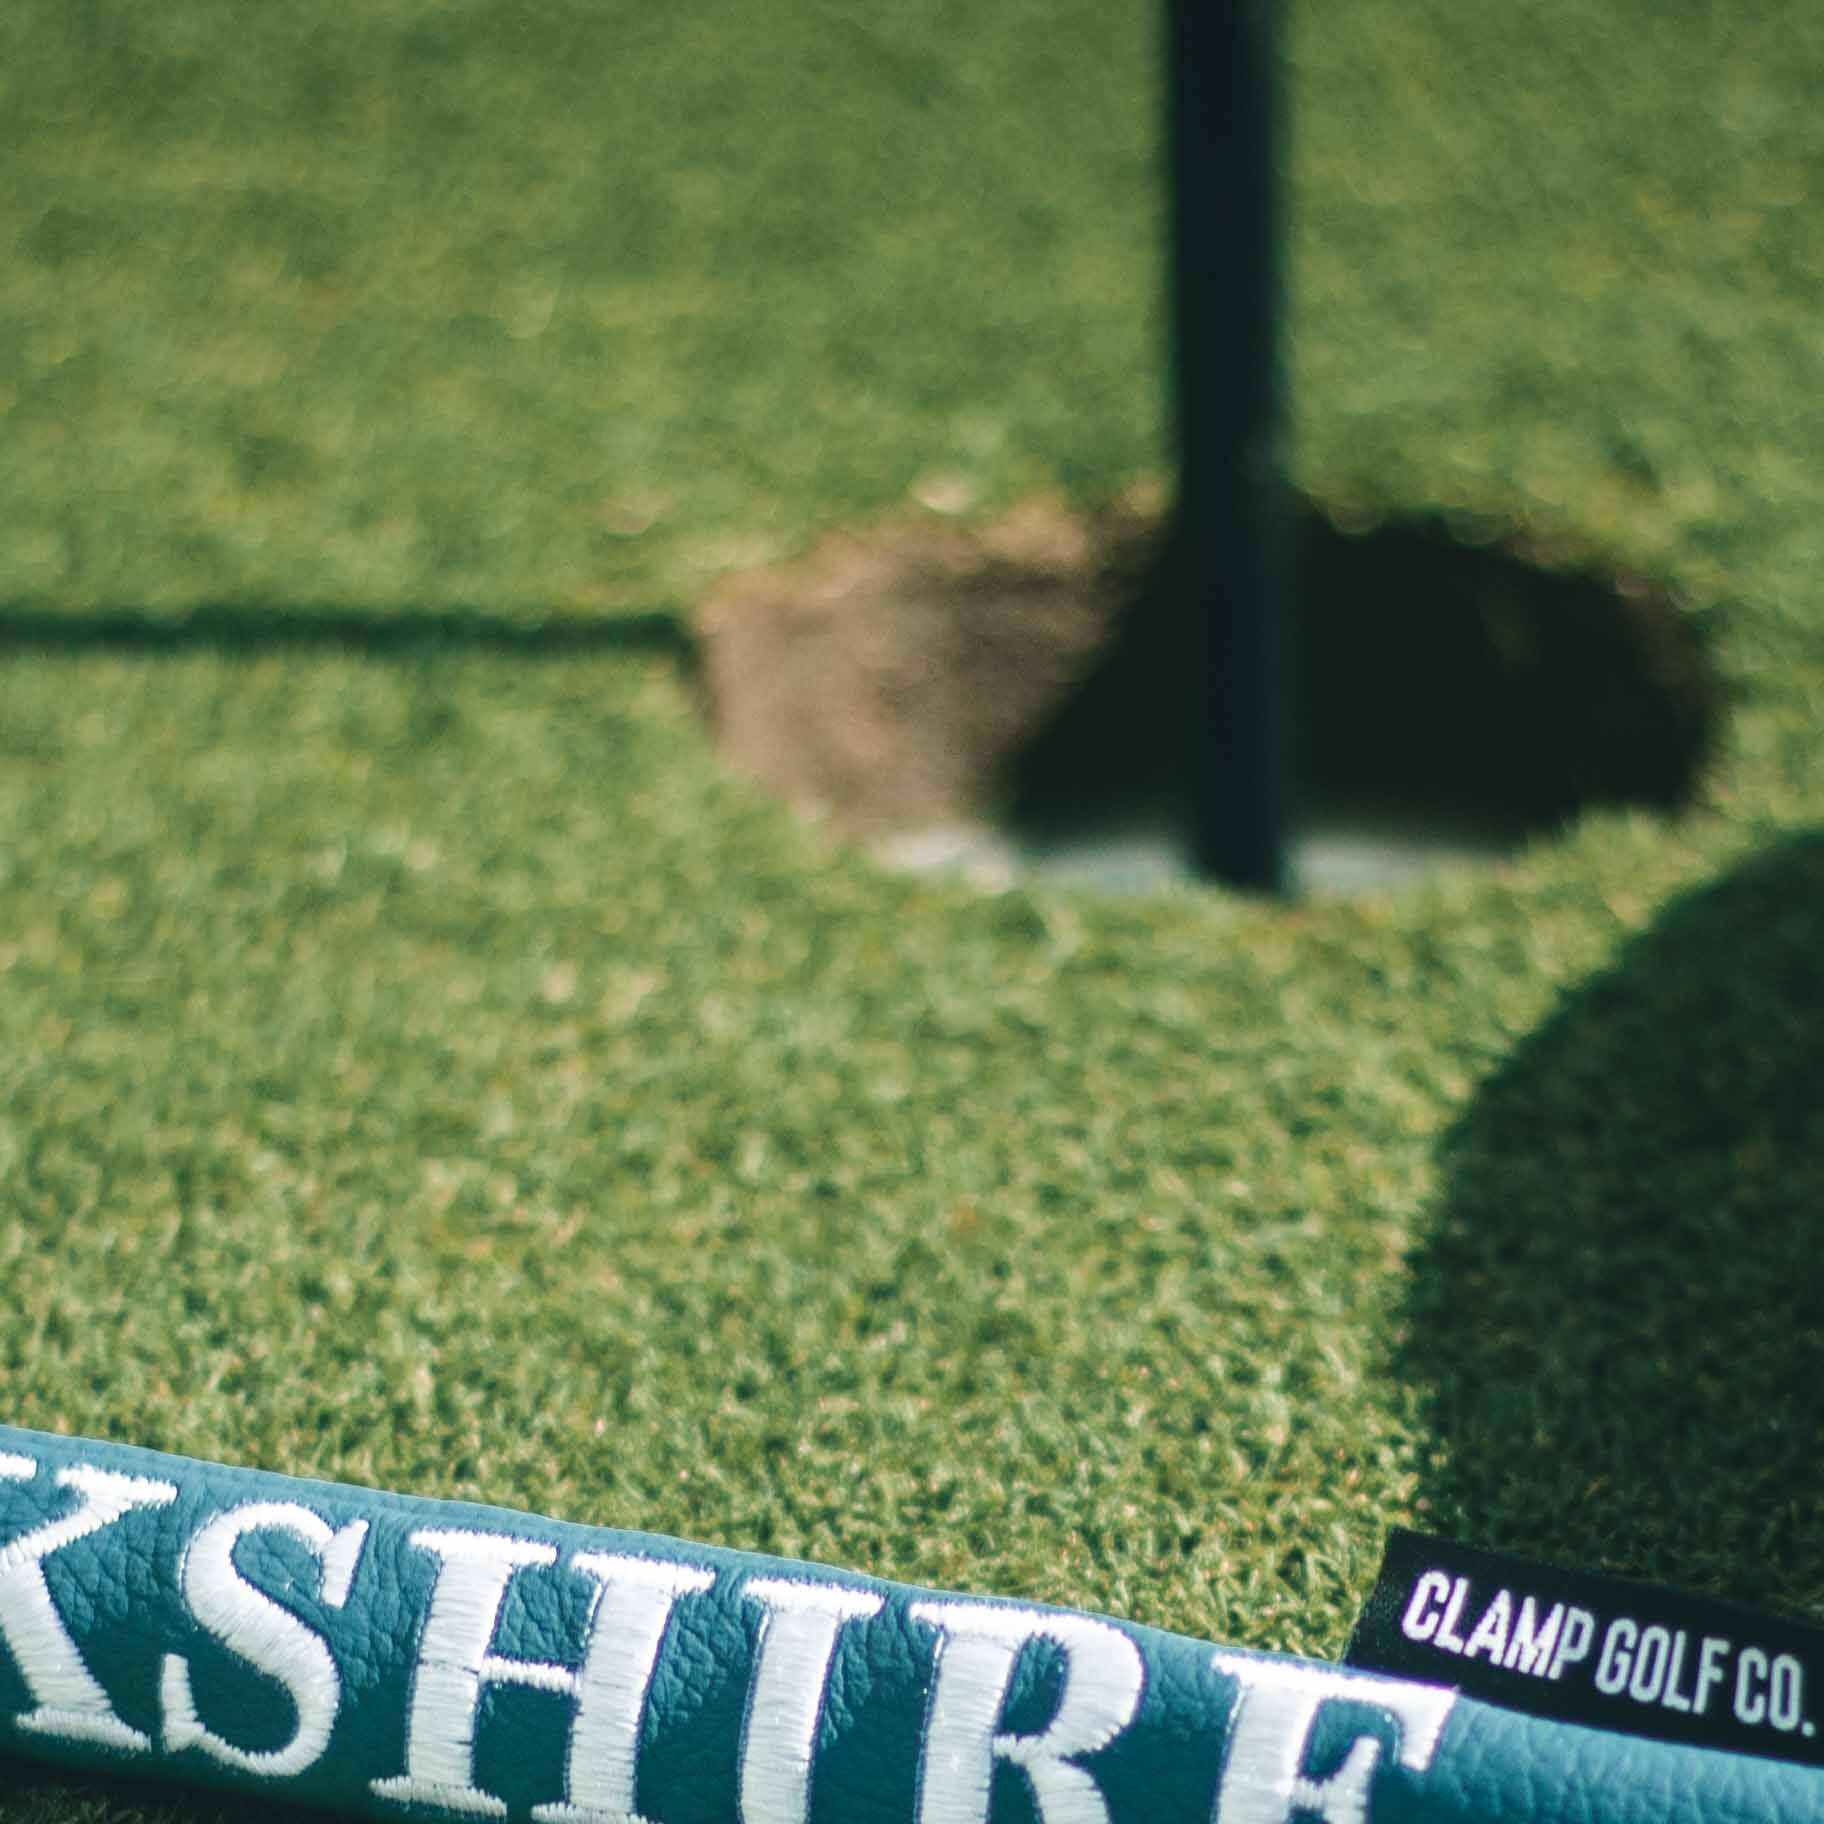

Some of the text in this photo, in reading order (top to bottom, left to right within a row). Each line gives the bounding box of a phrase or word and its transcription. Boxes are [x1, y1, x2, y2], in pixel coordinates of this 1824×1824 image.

[1401, 1570, 1816, 1738] CLAMP GOLF CO.
